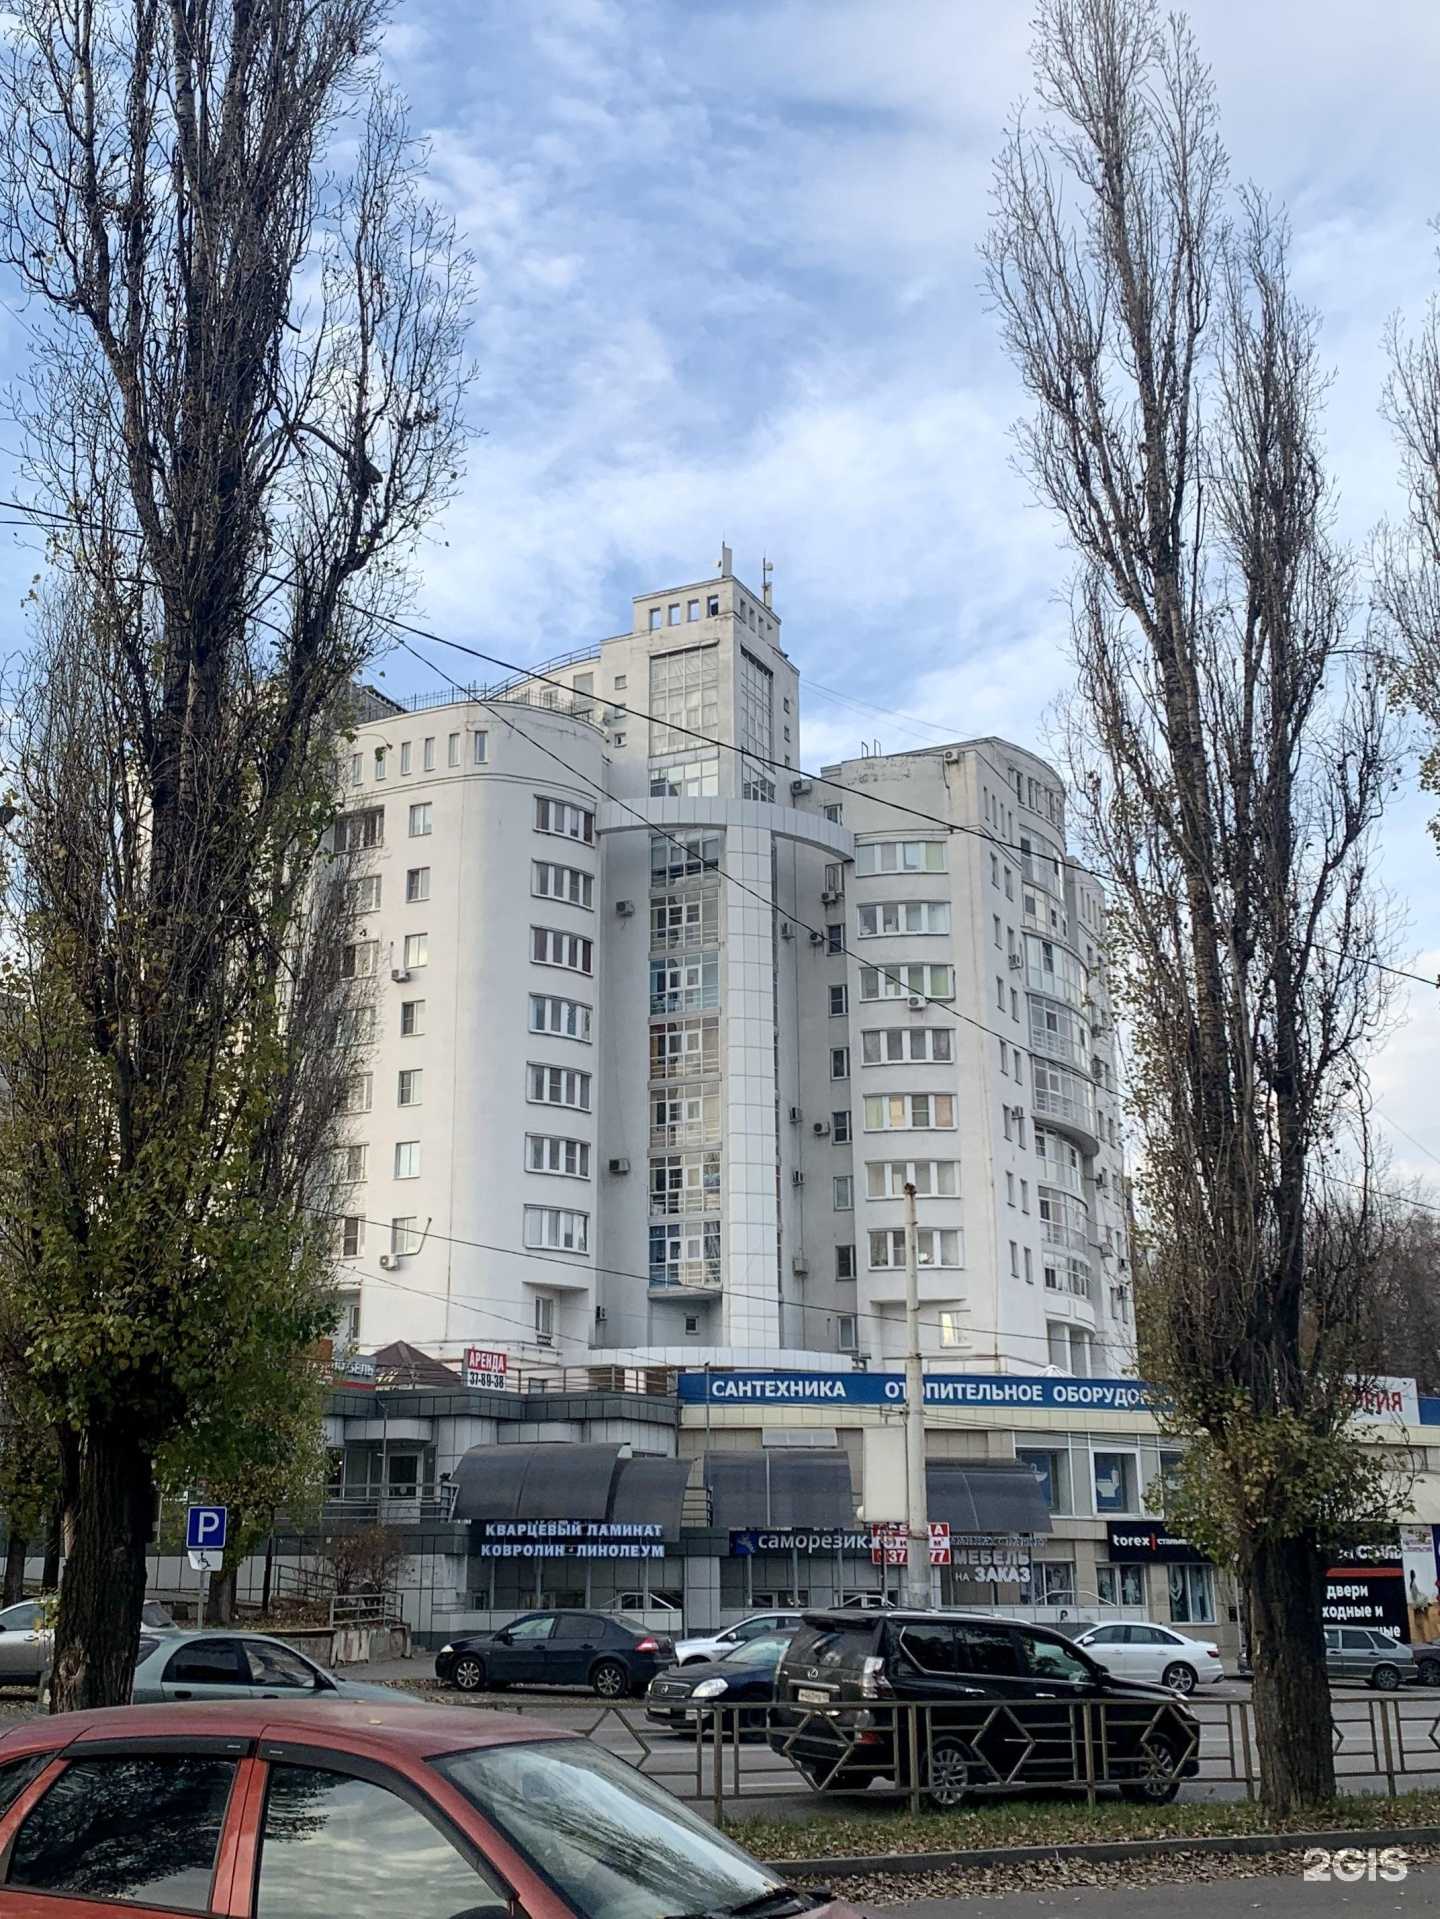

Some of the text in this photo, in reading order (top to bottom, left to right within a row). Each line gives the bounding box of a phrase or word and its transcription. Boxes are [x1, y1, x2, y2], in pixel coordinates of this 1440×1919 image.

[469, 1350, 504, 1373] АРЕНДА
[470, 1371, 504, 1389] 37-89-38
[711, 1380, 846, 1398] САНТЕХНИКА
[884, 1381, 1043, 1401] ОТПИТЕЛЬНОЕ
[197, 1511, 219, 1543] P
[485, 1521, 663, 1538] КВАРЦЕВЫЙ ЛАМИНАТ
[1113, 1534, 1150, 1546] torex
[481, 1544, 565, 1557] КОВРОЛИН
[576, 1545, 665, 1558] ЛИНОЛЕУМ
[954, 1551, 1030, 1566] МЕБЕЛЬ
[974, 1567, 1031, 1583] ЗАКАЗ
[1326, 1585, 1369, 1600] двери
[1321, 1606, 1384, 1621] ходные и
